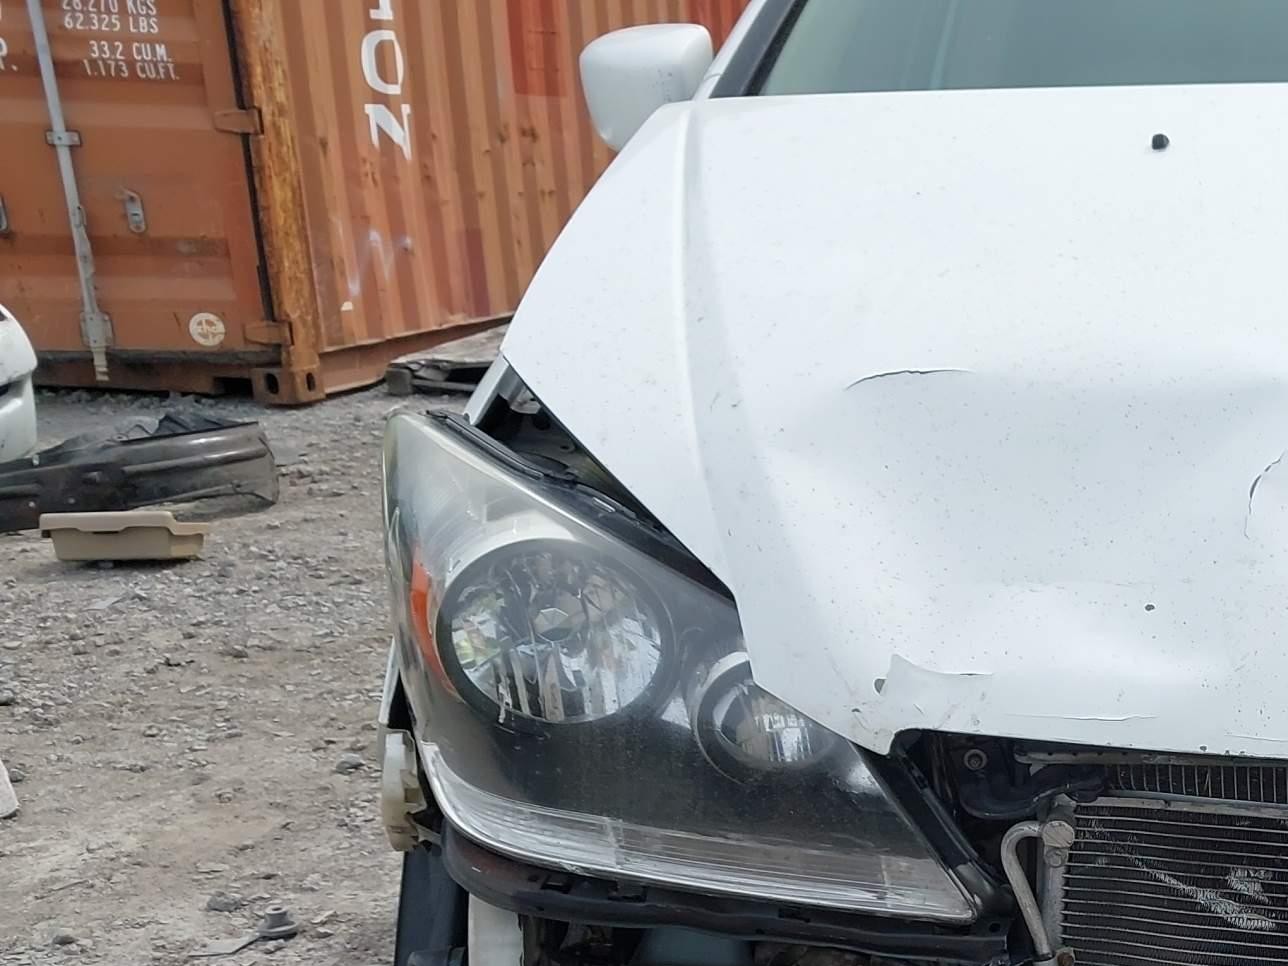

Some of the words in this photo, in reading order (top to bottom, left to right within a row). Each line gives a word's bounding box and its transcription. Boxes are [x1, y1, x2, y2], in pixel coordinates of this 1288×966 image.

[127, 0, 157, 15] KGS
[64, 13, 121, 31] 62.325
[129, 16, 159, 34] LBS
[88, 40, 125, 59] 33.2
[132, 42, 173, 62] CU.M.
[82, 59, 129, 78] 1.173
